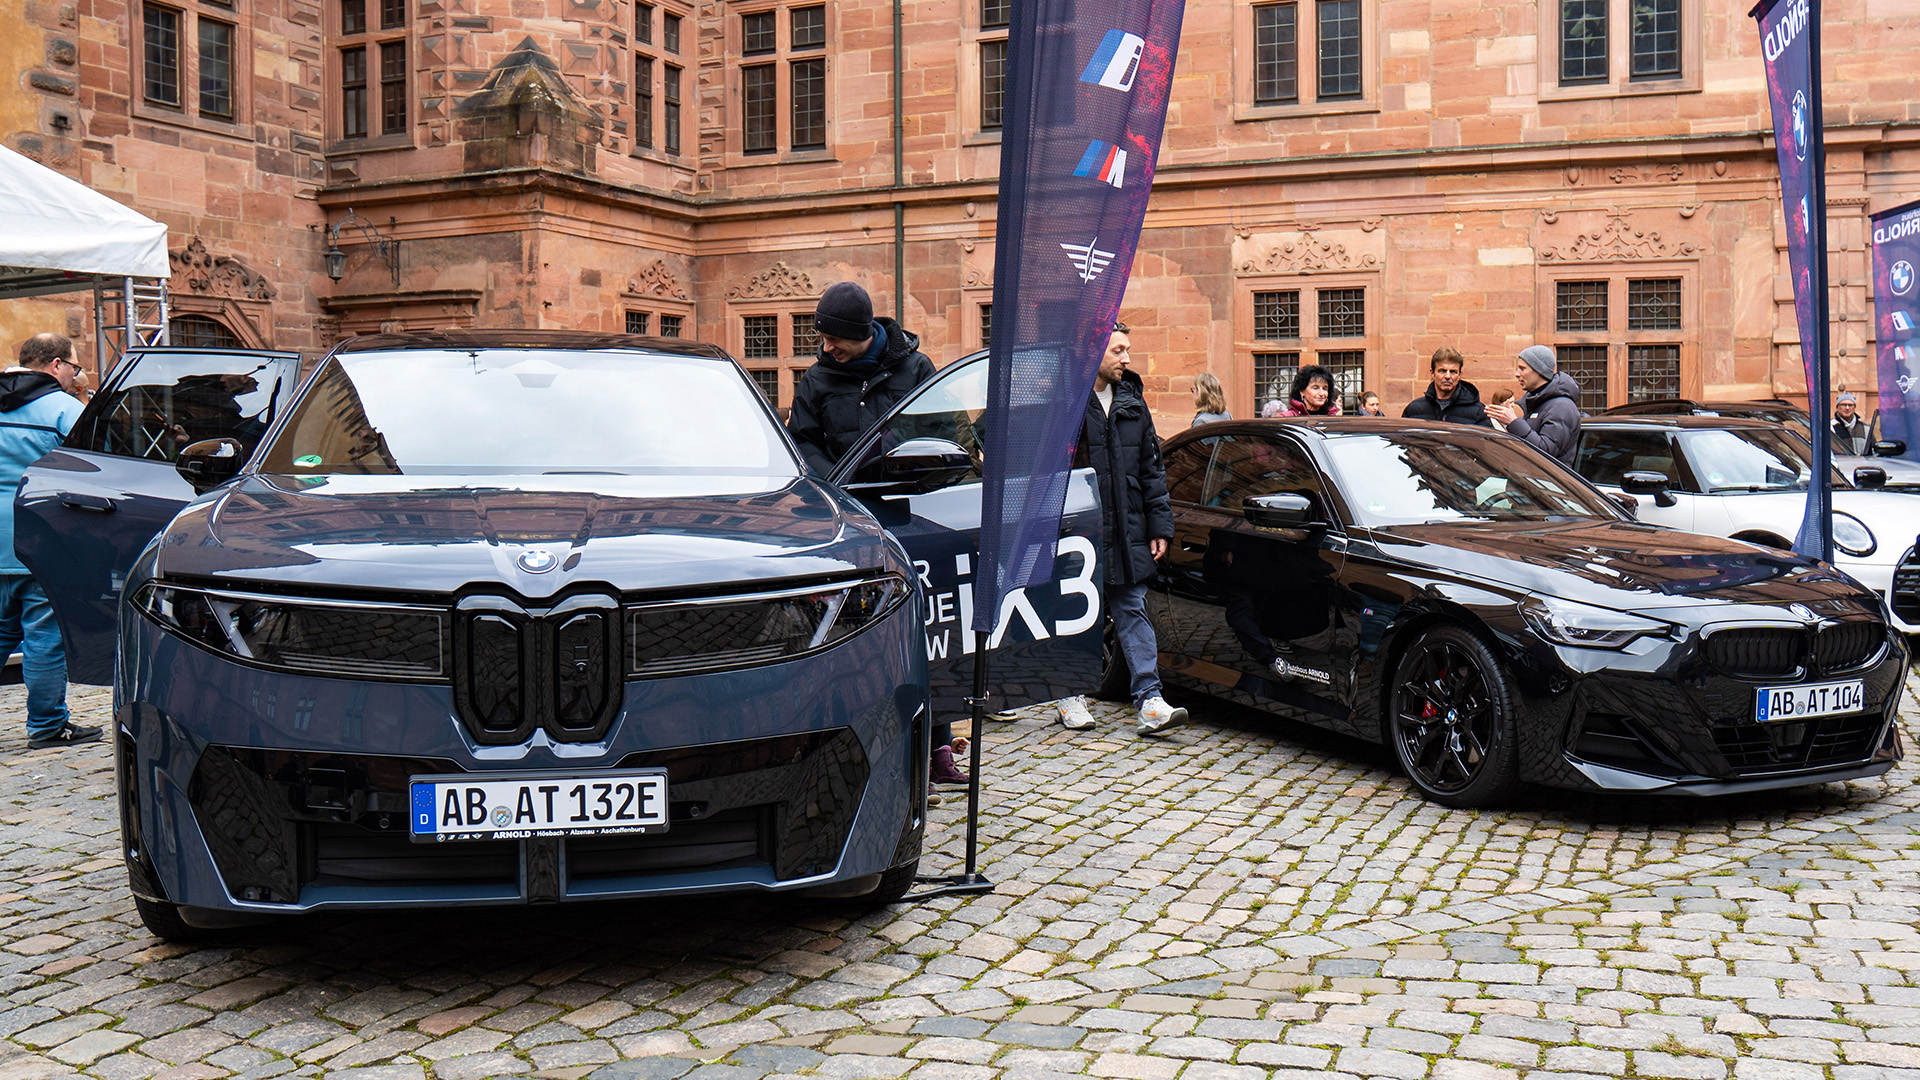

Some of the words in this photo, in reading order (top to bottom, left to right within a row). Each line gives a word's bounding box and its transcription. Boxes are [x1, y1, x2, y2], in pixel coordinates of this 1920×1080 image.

[1308, 668, 1330, 680] ARNOLD
[1770, 691, 1795, 716] AB
[1807, 688, 1829, 714] AT
[1832, 685, 1861, 711] 104
[420, 813, 429, 825] D
[442, 787, 488, 827] AB
[515, 785, 560, 824] AT
[569, 782, 659, 822] 132E
[493, 830, 531, 840] ARNOLD
[537, 829, 565, 837] Hösbach
[570, 828, 595, 836] Alzenau
[601, 826, 646, 835] Aschaffenburg
